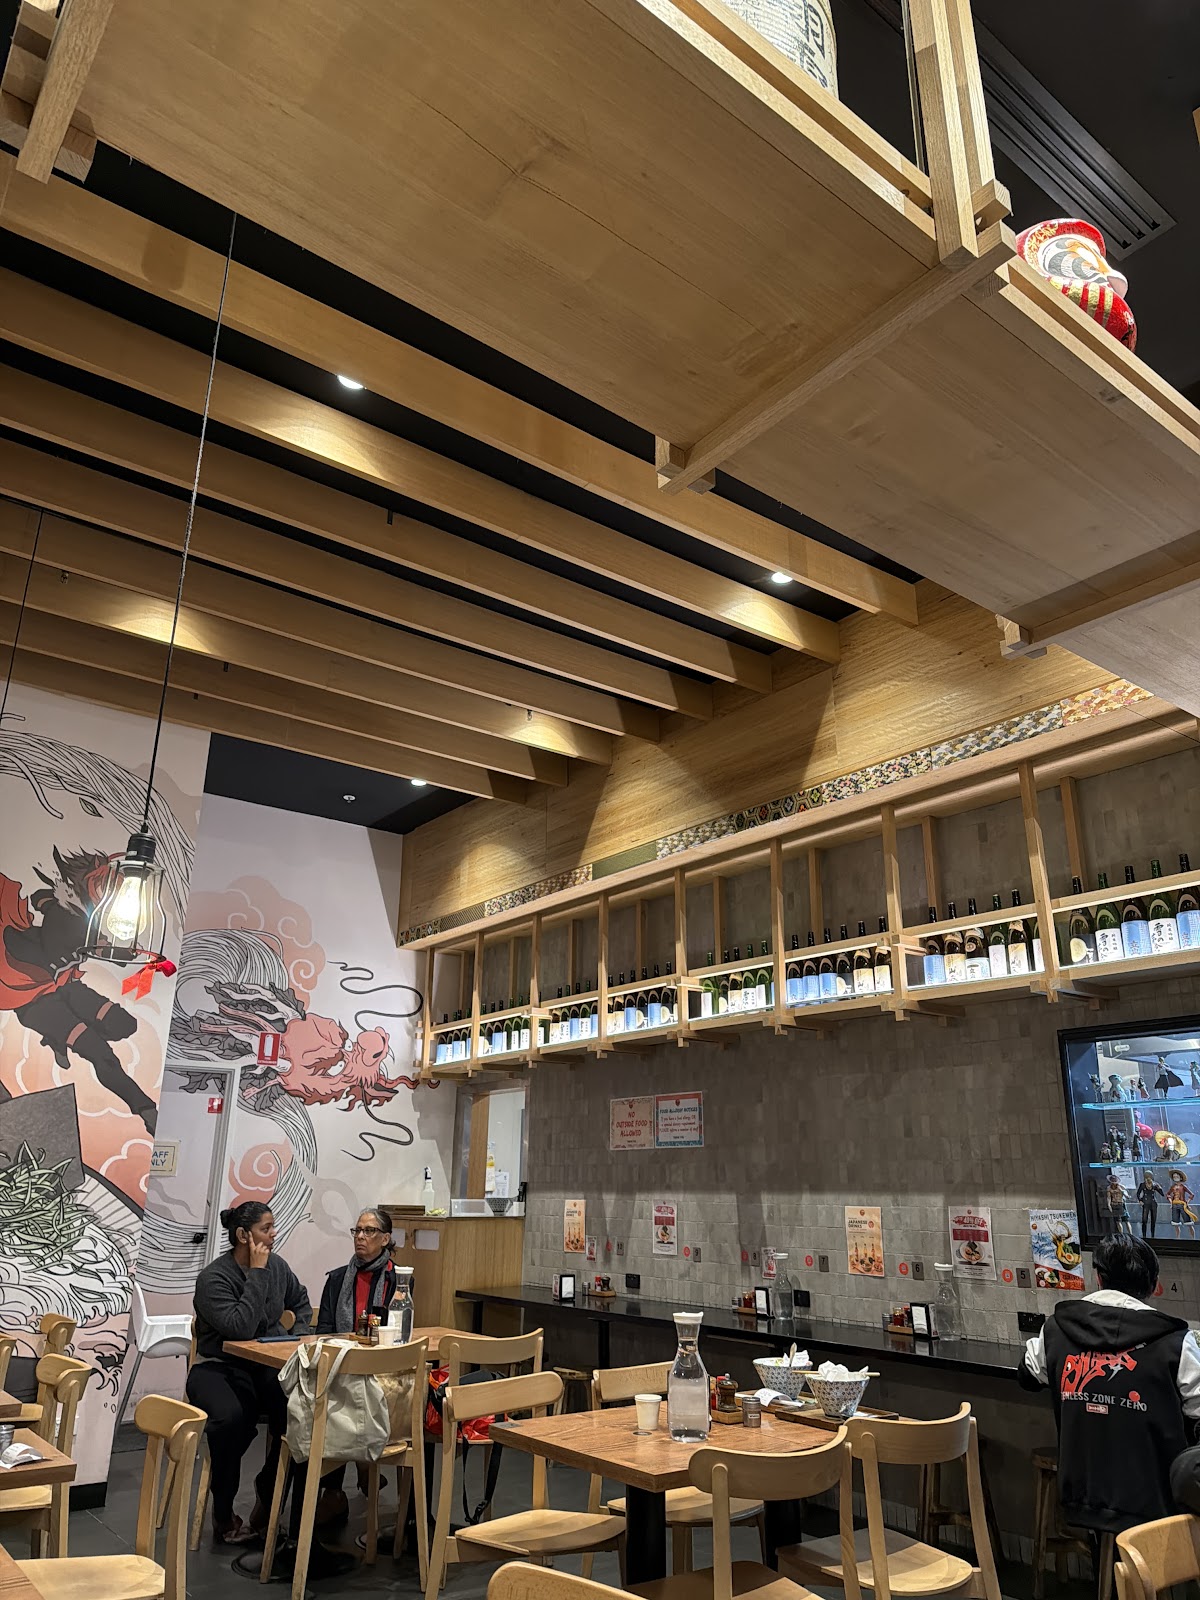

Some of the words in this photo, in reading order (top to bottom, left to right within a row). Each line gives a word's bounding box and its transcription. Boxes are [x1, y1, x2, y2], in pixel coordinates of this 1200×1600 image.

[635, 1119, 648, 1127] FOOD
[152, 1151, 169, 1159] AFF
[151, 1159, 167, 1167] NLY
[963, 1216, 974, 1224] 40%
[974, 1217, 984, 1225] OFF
[1030, 1213, 1049, 1221] HIYASHI
[1049, 1211, 1076, 1220] TSUKEMEN
[695, 1249, 699, 1257] 9
[916, 1264, 920, 1273] 6
[1021, 1270, 1026, 1279] 5
[1171, 1283, 1178, 1292] 4
[1061, 1391, 1089, 1401] ENLESS
[1092, 1393, 1116, 1404] ZONE
[1120, 1398, 1147, 1412] ZERO
